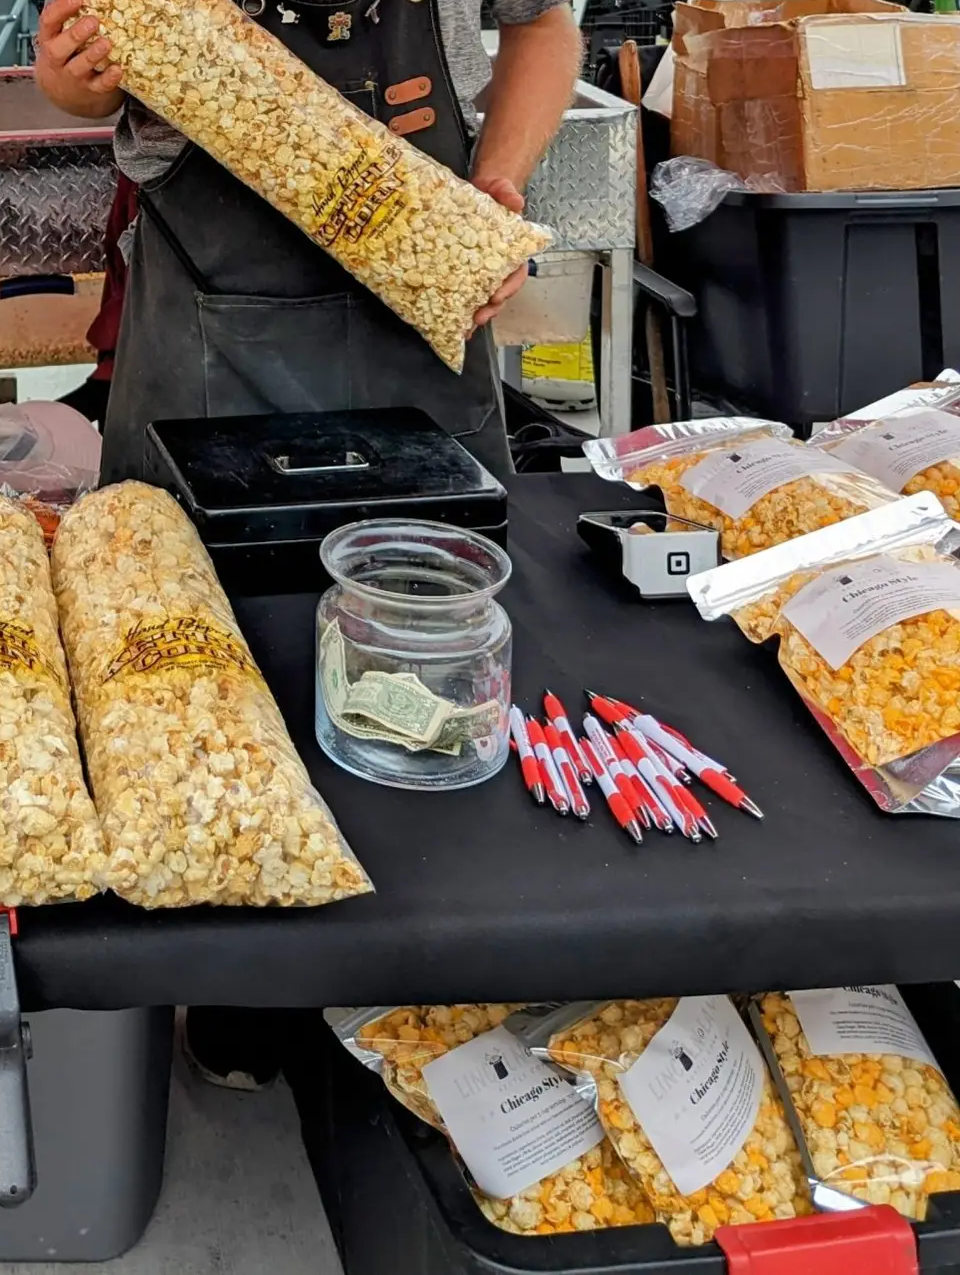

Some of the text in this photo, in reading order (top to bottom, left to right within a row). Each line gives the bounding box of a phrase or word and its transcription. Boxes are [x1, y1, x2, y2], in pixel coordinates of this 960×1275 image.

[842, 580, 889, 604] Chicago
[500, 1083, 543, 1115] Chicago
[541, 1075, 564, 1093] Styl
[690, 1065, 721, 1105] Chicago
